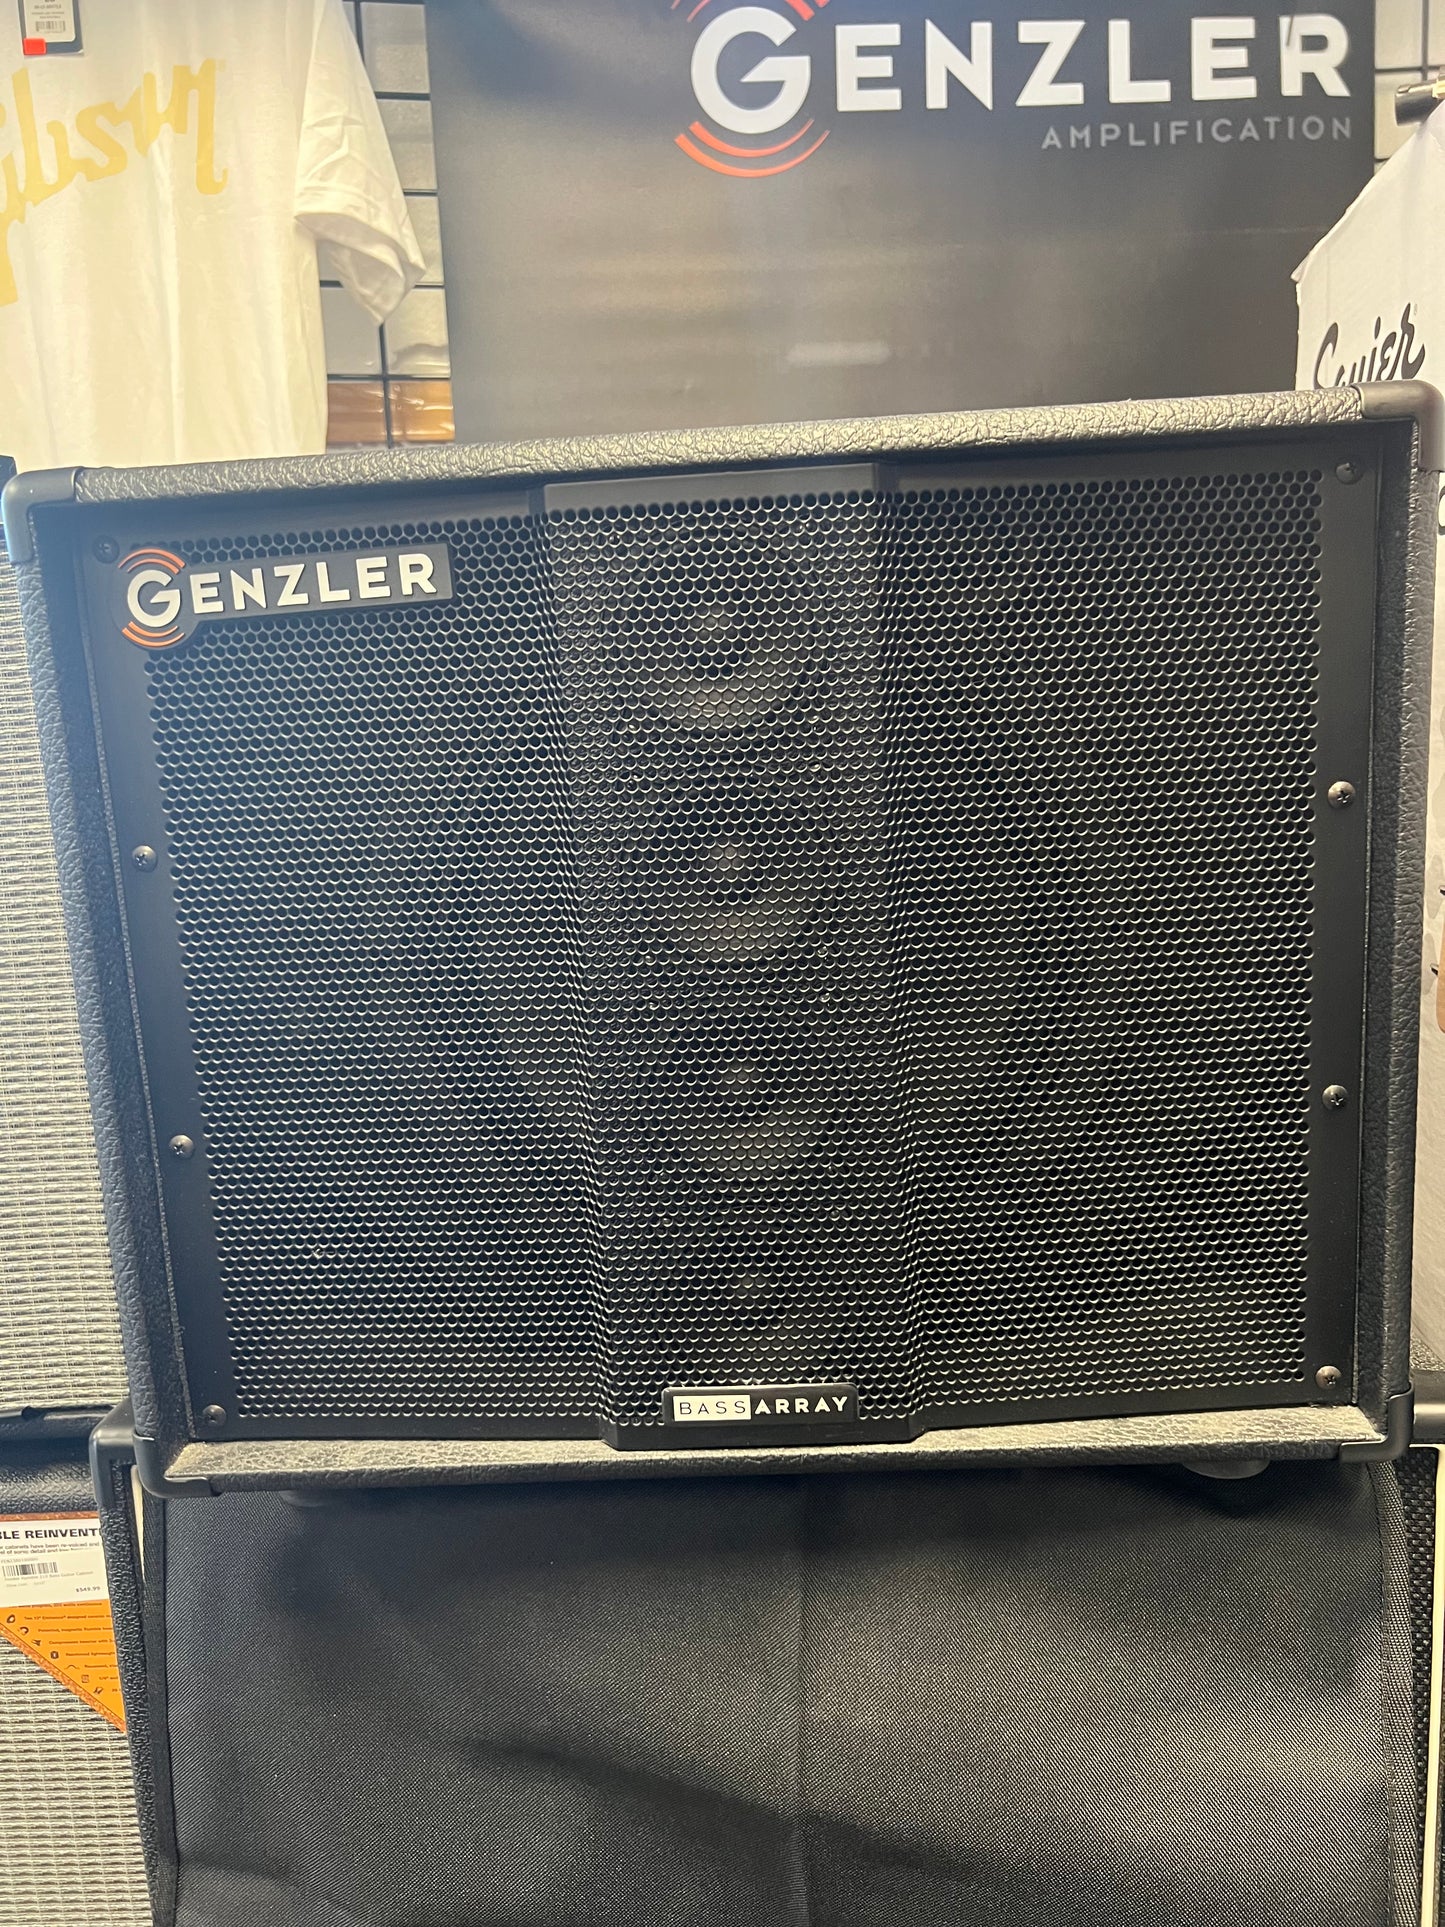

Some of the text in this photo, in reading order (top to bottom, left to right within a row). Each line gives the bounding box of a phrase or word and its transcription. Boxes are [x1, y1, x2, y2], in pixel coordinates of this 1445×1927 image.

[690, 6, 1352, 134] GENZLER
[1041, 116, 1352, 150] AMPLIFICATION
[127, 552, 438, 627] GENZLER
[0, 1528, 101, 1540] LE REINVENT
